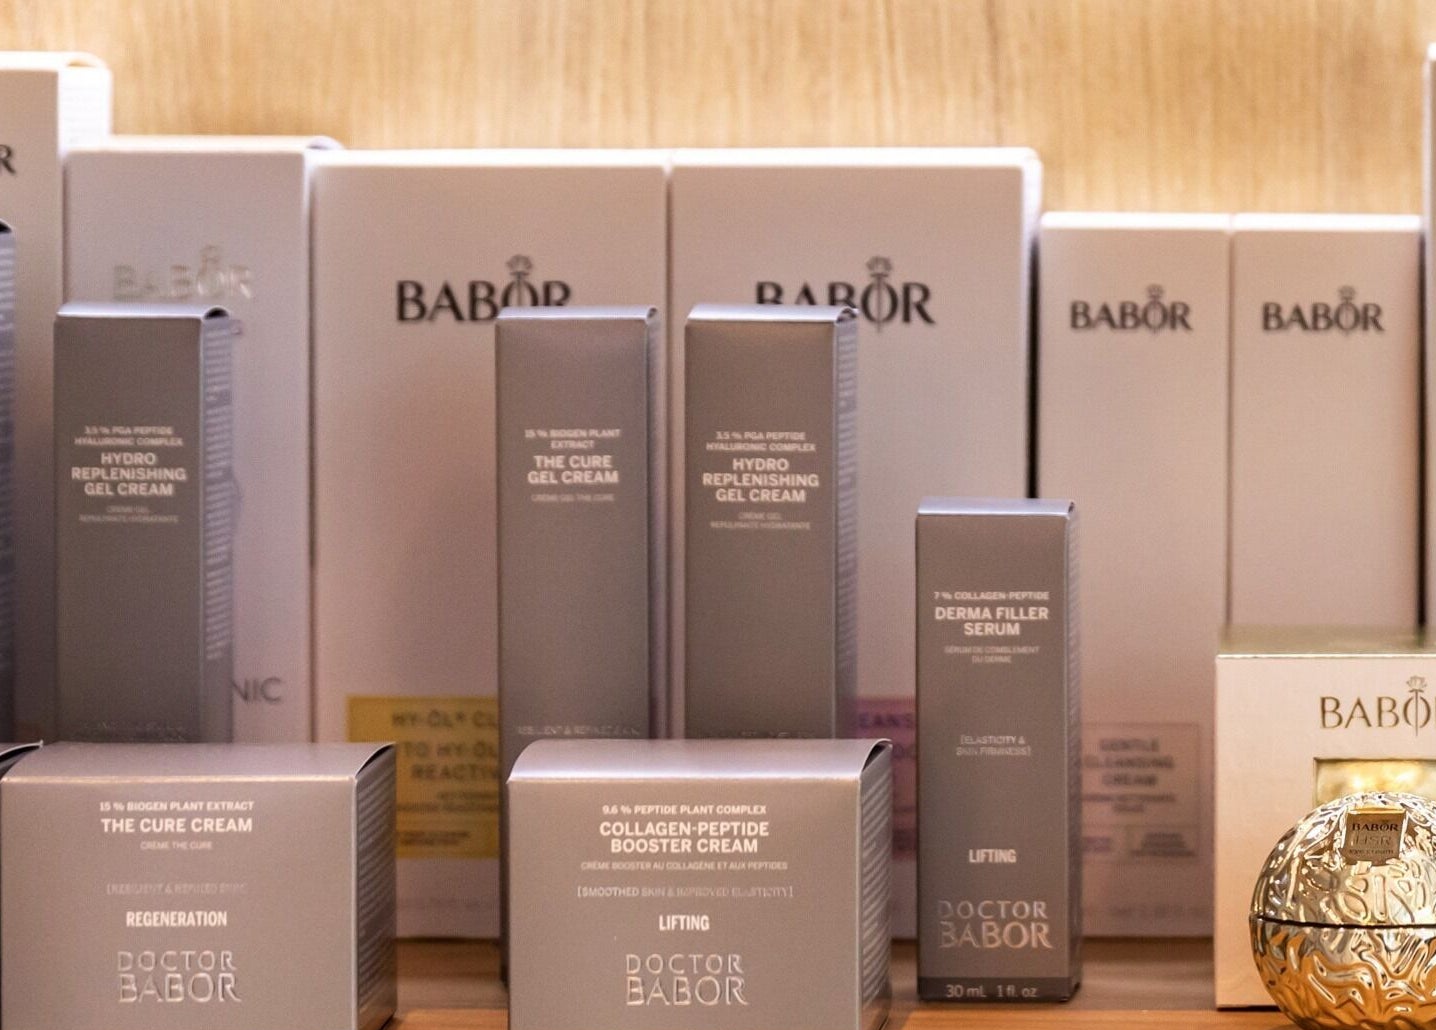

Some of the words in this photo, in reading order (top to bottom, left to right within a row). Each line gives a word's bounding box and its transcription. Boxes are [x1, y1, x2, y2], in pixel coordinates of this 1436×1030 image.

[1070, 301, 1192, 332] BABOR
[1262, 302, 1385, 333] BABOR
[100, 452, 156, 466] HYDRO
[533, 455, 565, 469] THE
[568, 455, 612, 469] CURE
[732, 458, 789, 471] HYDRO
[71, 467, 187, 480] REPLENISHING
[528, 470, 558, 484] GEL
[561, 470, 619, 484] CREAM
[702, 473, 820, 487] REPLENISHING
[84, 482, 114, 496] GEL
[117, 482, 174, 496] CREAM
[716, 488, 746, 502] GEL
[749, 488, 806, 502] CREAM
[935, 607, 992, 620] DERMA
[996, 607, 1049, 620] FILLER
[964, 622, 1020, 636] SERUM
[100, 801, 111, 812] 15
[113, 801, 125, 812] %
[127, 801, 167, 812] BIOGEN
[169, 801, 204, 812] PLANT
[206, 801, 255, 812] EXTRACT
[634, 805, 677, 815] PEPTIDE
[679, 805, 714, 815] PLANT
[716, 805, 767, 815] COMPLEX
[101, 818, 135, 833] THE
[139, 818, 187, 833] CURE
[191, 818, 253, 833] CREAM
[599, 821, 770, 837] COLLAGEN-PEPTIDE
[1352, 823, 1399, 831] BABOR
[610, 838, 693, 853] BOOSTER
[696, 838, 758, 853] CREAM
[968, 849, 1017, 863] LIFTING
[577, 885, 640, 898] [SMOOTHED
[937, 900, 1048, 919] DOCTOR
[126, 911, 228, 927] REGENERATION
[659, 915, 710, 931] LIFTING
[940, 921, 1053, 949] BABOR
[118, 950, 237, 972] DOCTOR
[626, 954, 744, 974] DOCTOR
[118, 973, 242, 1003] BABOR
[626, 976, 749, 1006] BABOR
[946, 985, 963, 997] 30
[967, 985, 986, 997] mL
